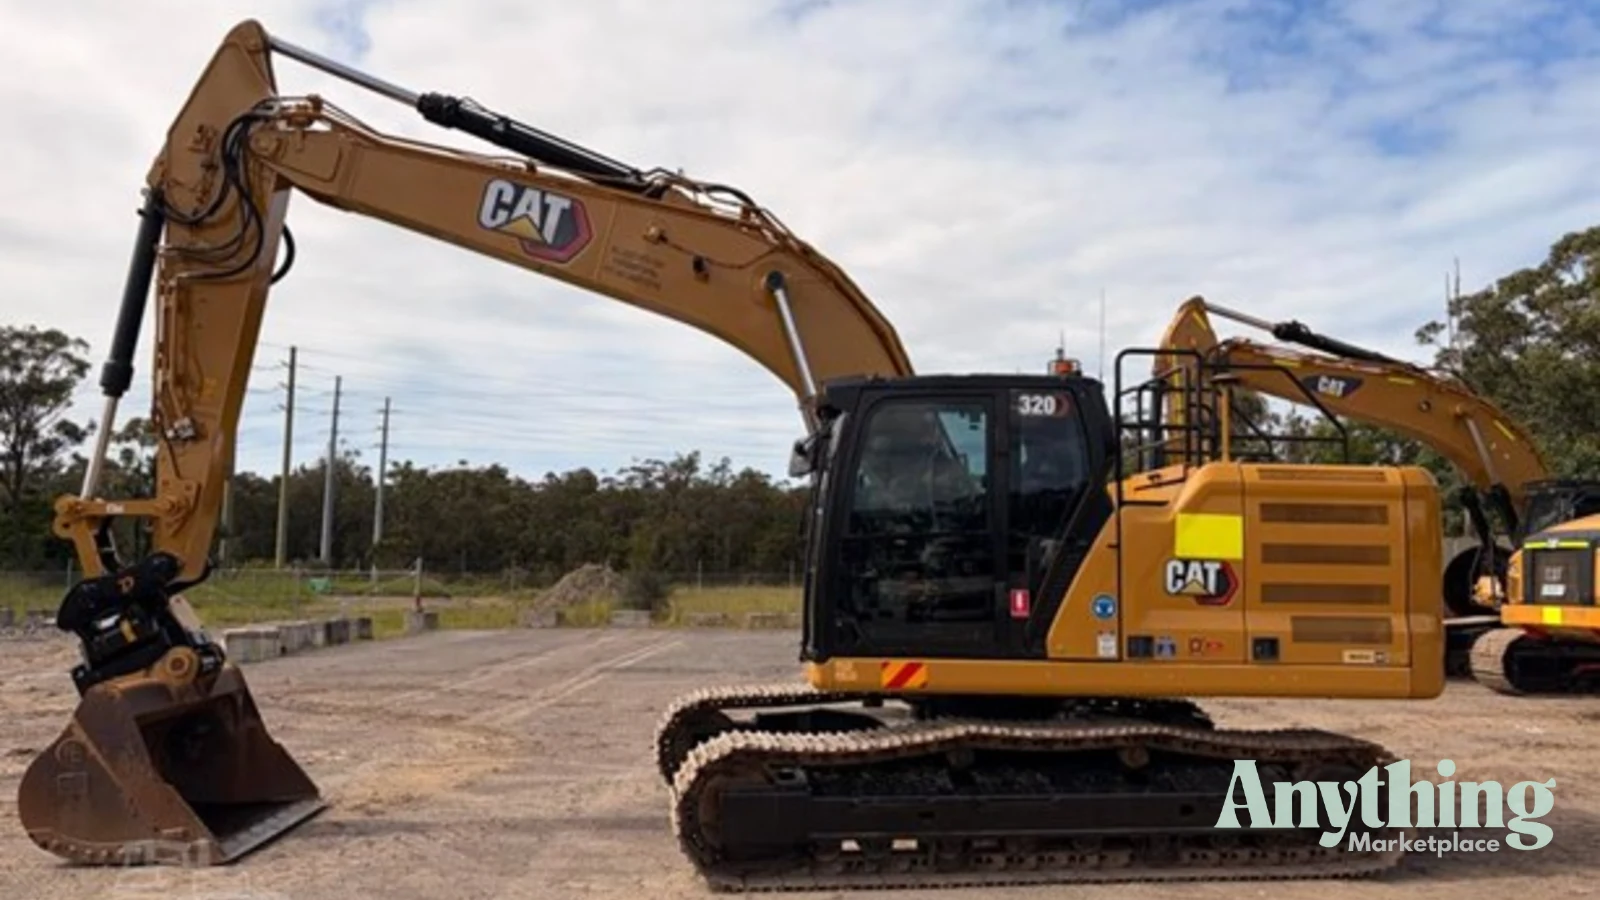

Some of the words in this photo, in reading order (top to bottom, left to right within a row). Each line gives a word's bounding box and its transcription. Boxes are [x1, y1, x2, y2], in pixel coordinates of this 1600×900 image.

[479, 179, 572, 244] CAT
[1318, 376, 1346, 397] CAT
[1019, 395, 1056, 415] 320
[1167, 560, 1221, 595] CAT
